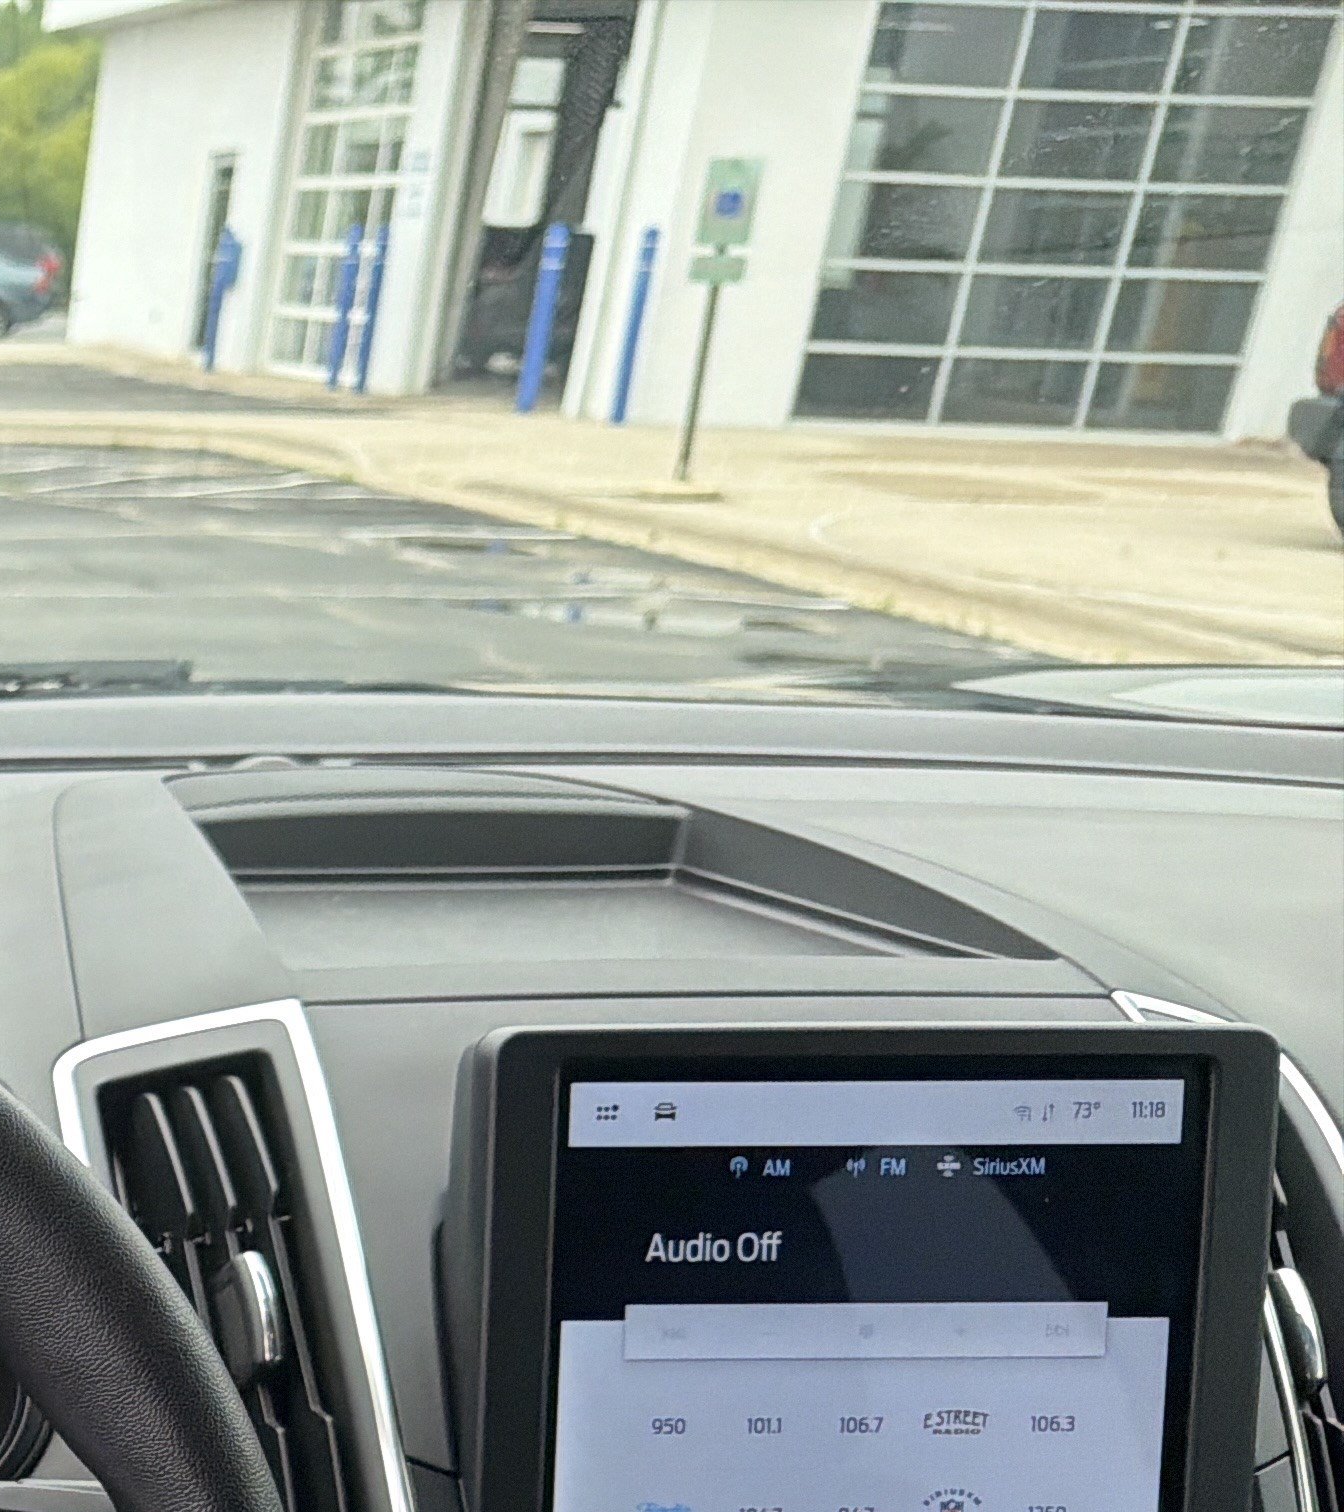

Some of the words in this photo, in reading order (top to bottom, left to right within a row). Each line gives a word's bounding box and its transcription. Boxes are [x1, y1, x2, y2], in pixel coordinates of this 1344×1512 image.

[1073, 1101, 1101, 1120] 73°
[1132, 1101, 1166, 1119] 11:18
[763, 1159, 791, 1177] AM
[880, 1158, 906, 1177] FM
[973, 1157, 1046, 1176] SiriusXM
[645, 1232, 729, 1263] Audio
[737, 1231, 782, 1262] Off
[652, 1417, 686, 1434] 950
[747, 1417, 783, 1434] 101.1
[840, 1417, 883, 1433] 106.7
[936, 1410, 990, 1428] STREET
[1031, 1415, 1075, 1432] 106.3
